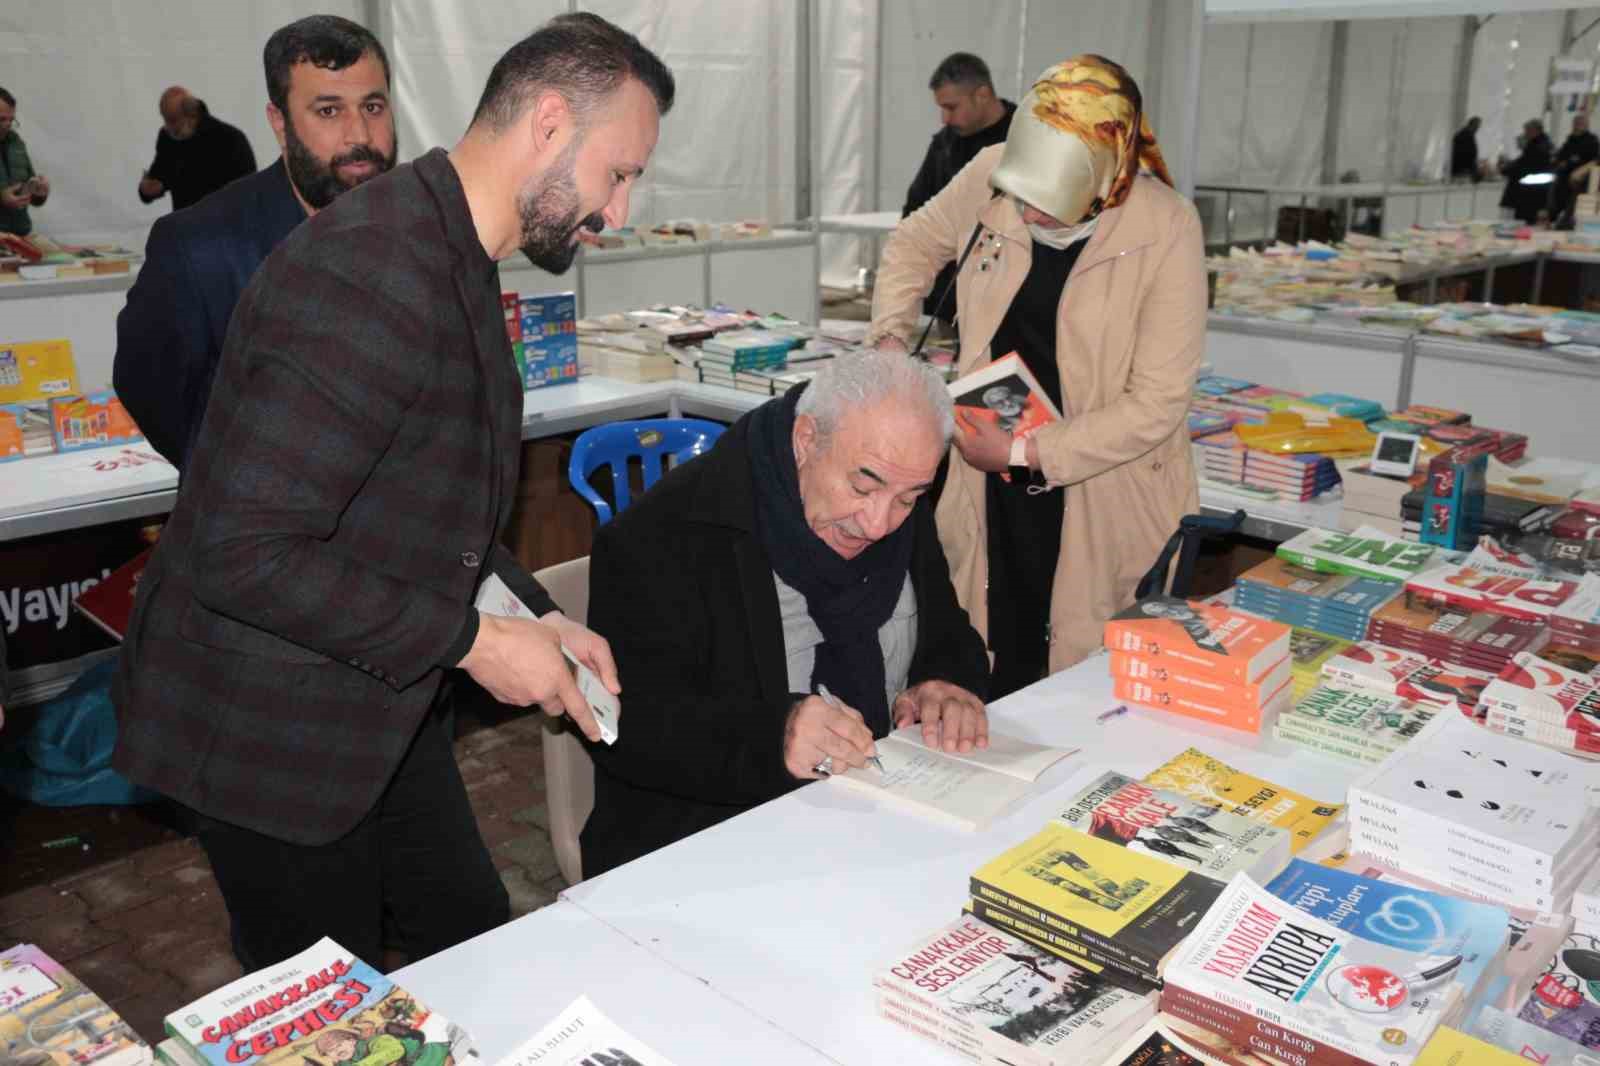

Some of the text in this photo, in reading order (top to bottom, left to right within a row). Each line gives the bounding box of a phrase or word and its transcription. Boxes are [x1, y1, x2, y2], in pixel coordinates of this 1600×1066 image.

[1242, 922, 1337, 1002] AVRUPA
[225, 979, 372, 1064] CEPHESİ
[1250, 1035, 1272, 1051] Can
[1257, 1021, 1280, 1038] Can
[1282, 1031, 1315, 1053] Kırığı
